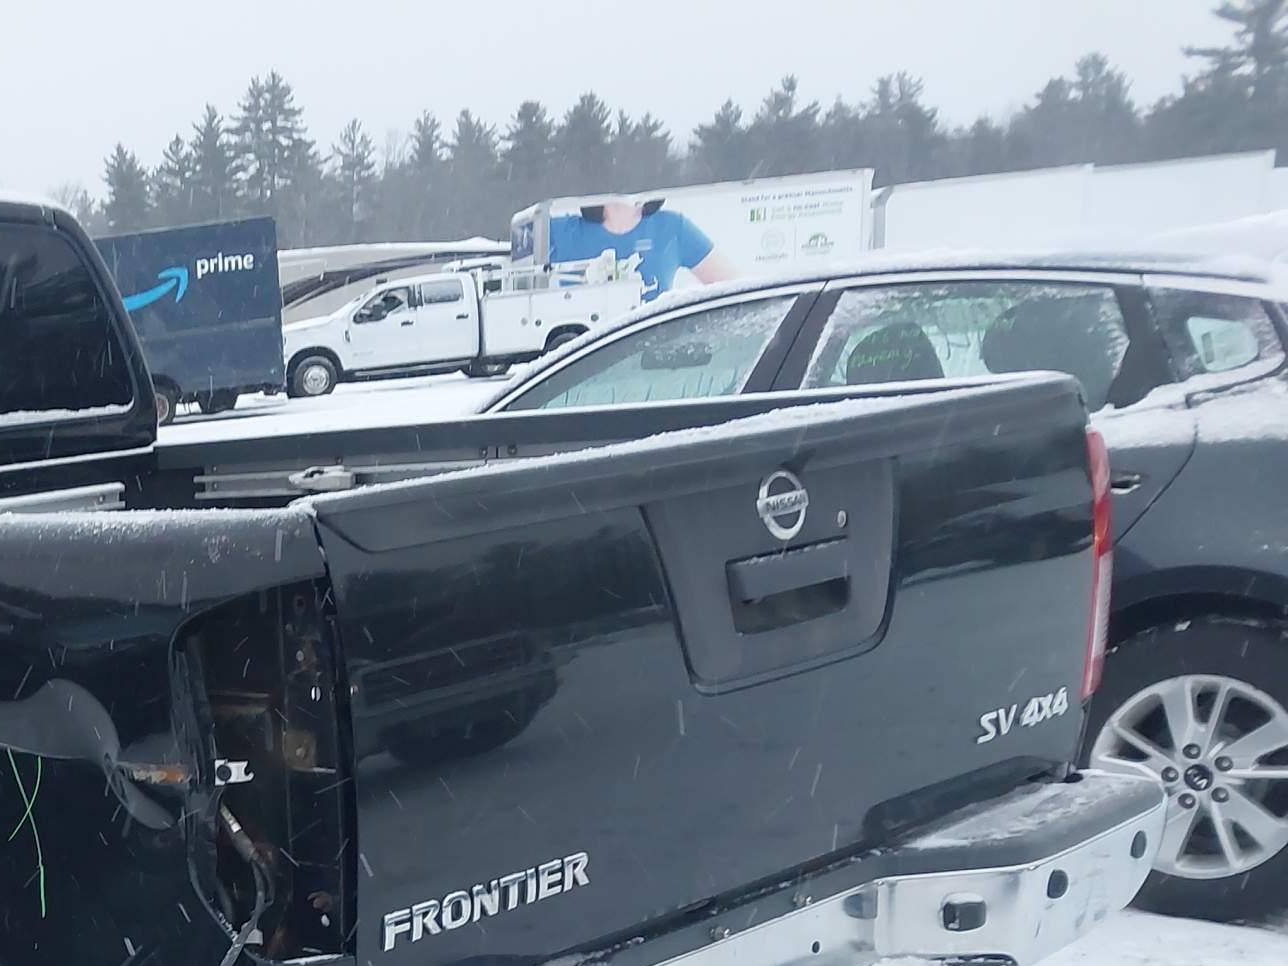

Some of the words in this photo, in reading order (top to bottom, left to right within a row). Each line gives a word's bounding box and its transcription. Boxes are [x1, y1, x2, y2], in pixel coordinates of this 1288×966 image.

[197, 252, 254, 279] prime
[766, 493, 806, 512] NISSAN
[977, 703, 1018, 745] SV
[383, 851, 591, 953] FRONTIER
